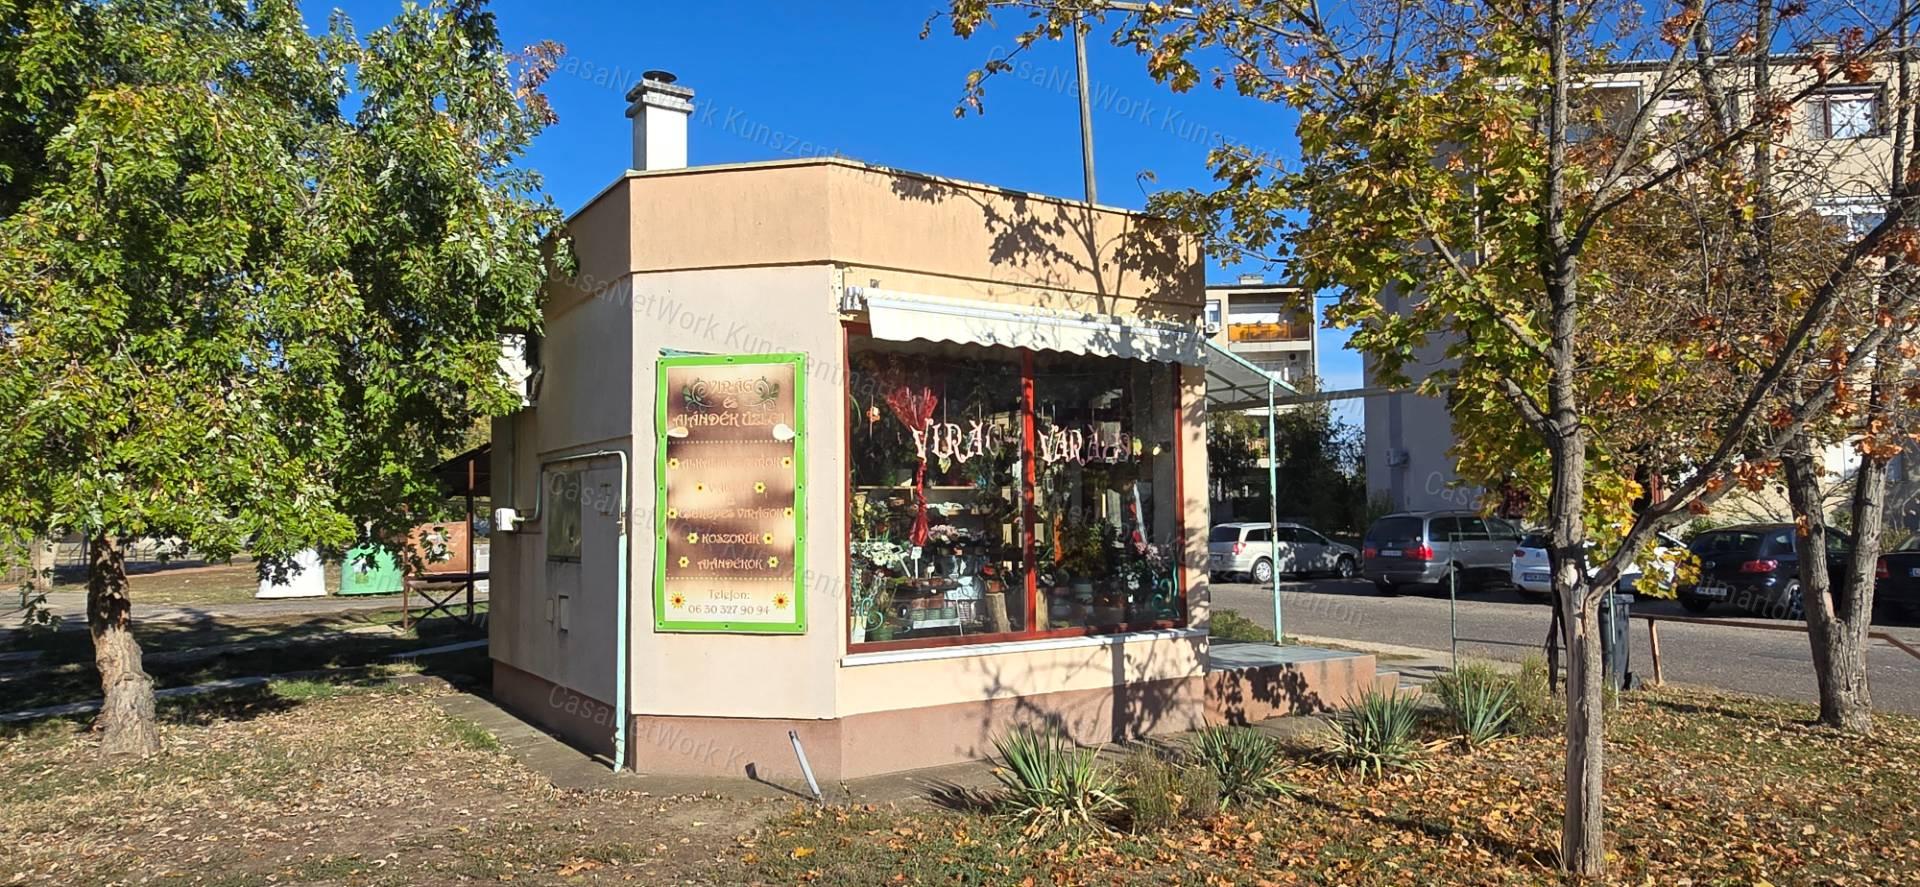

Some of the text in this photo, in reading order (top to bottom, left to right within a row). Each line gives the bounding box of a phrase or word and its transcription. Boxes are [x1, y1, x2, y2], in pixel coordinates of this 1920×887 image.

[673, 411, 740, 428] AJÁNDÉK
[697, 557, 764, 571] AJÁNDÉKOK
[708, 589, 751, 602] Telefon:
[688, 605, 769, 616] 06 30 327 90 94
